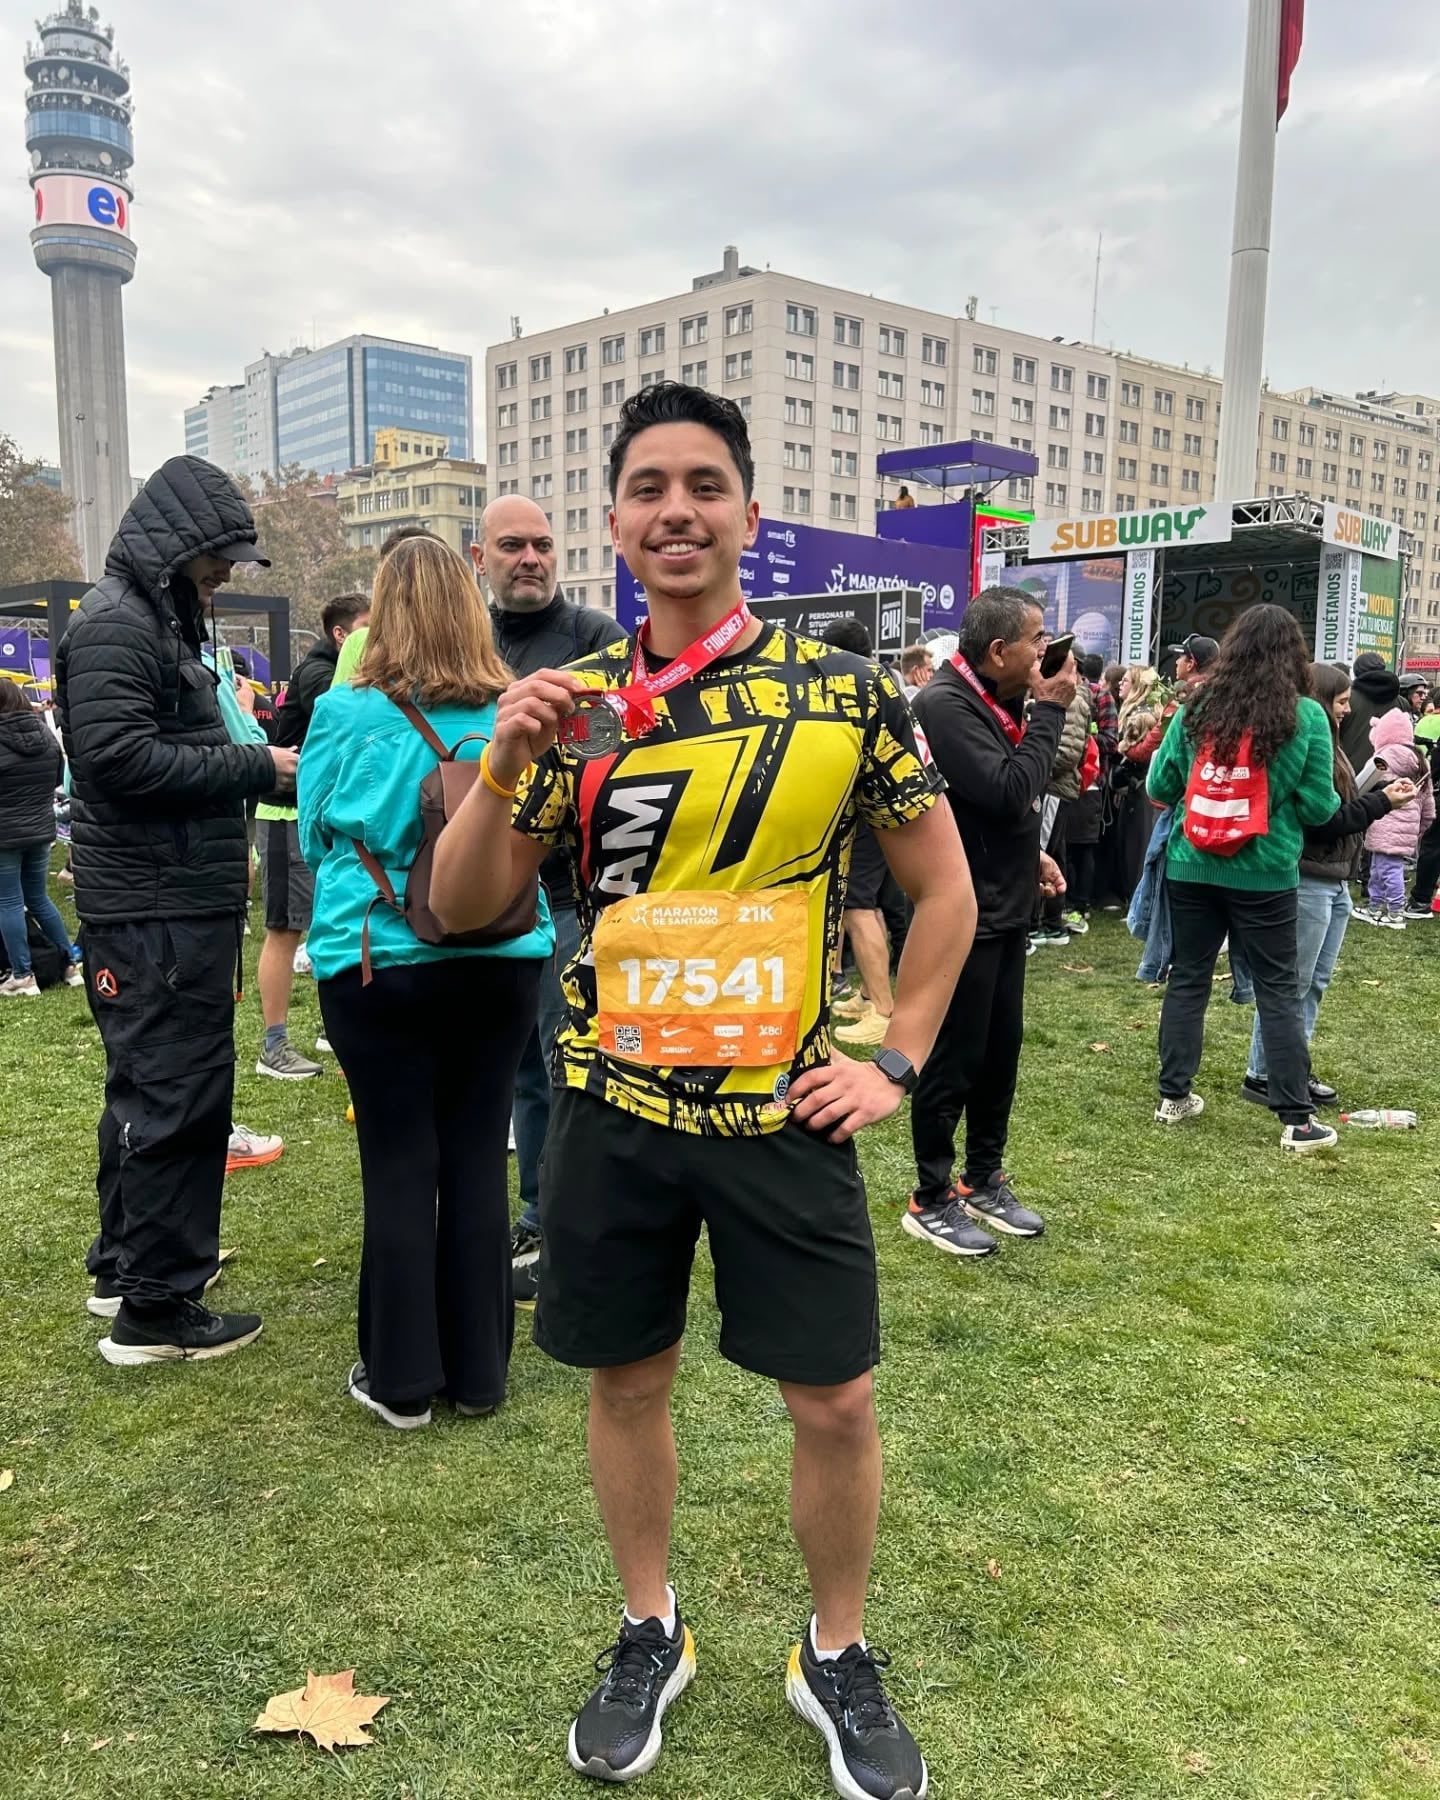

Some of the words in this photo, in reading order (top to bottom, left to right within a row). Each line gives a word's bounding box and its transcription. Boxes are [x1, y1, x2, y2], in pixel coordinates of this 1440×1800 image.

[1050, 506, 1207, 552] SUBWAY
[1334, 511, 1392, 552] SUBWAY
[849, 573, 908, 590] MARATÓN
[808, 611, 843, 620] PERSONAS
[845, 610, 855, 618] EN
[808, 620, 832, 629] SITUAC
[881, 608, 901, 640] 21K
[1129, 572, 1146, 660] ETIQUÉTANOS
[1323, 573, 1341, 660] ETIQUÉTANOS
[702, 613, 745, 655] FINISHER
[652, 905, 718, 917] MARATÓN
[737, 905, 775, 923] 21K
[652, 917, 666, 925] DE
[668, 917, 719, 925] SANTIAGO
[618, 956, 785, 1006] 17541
